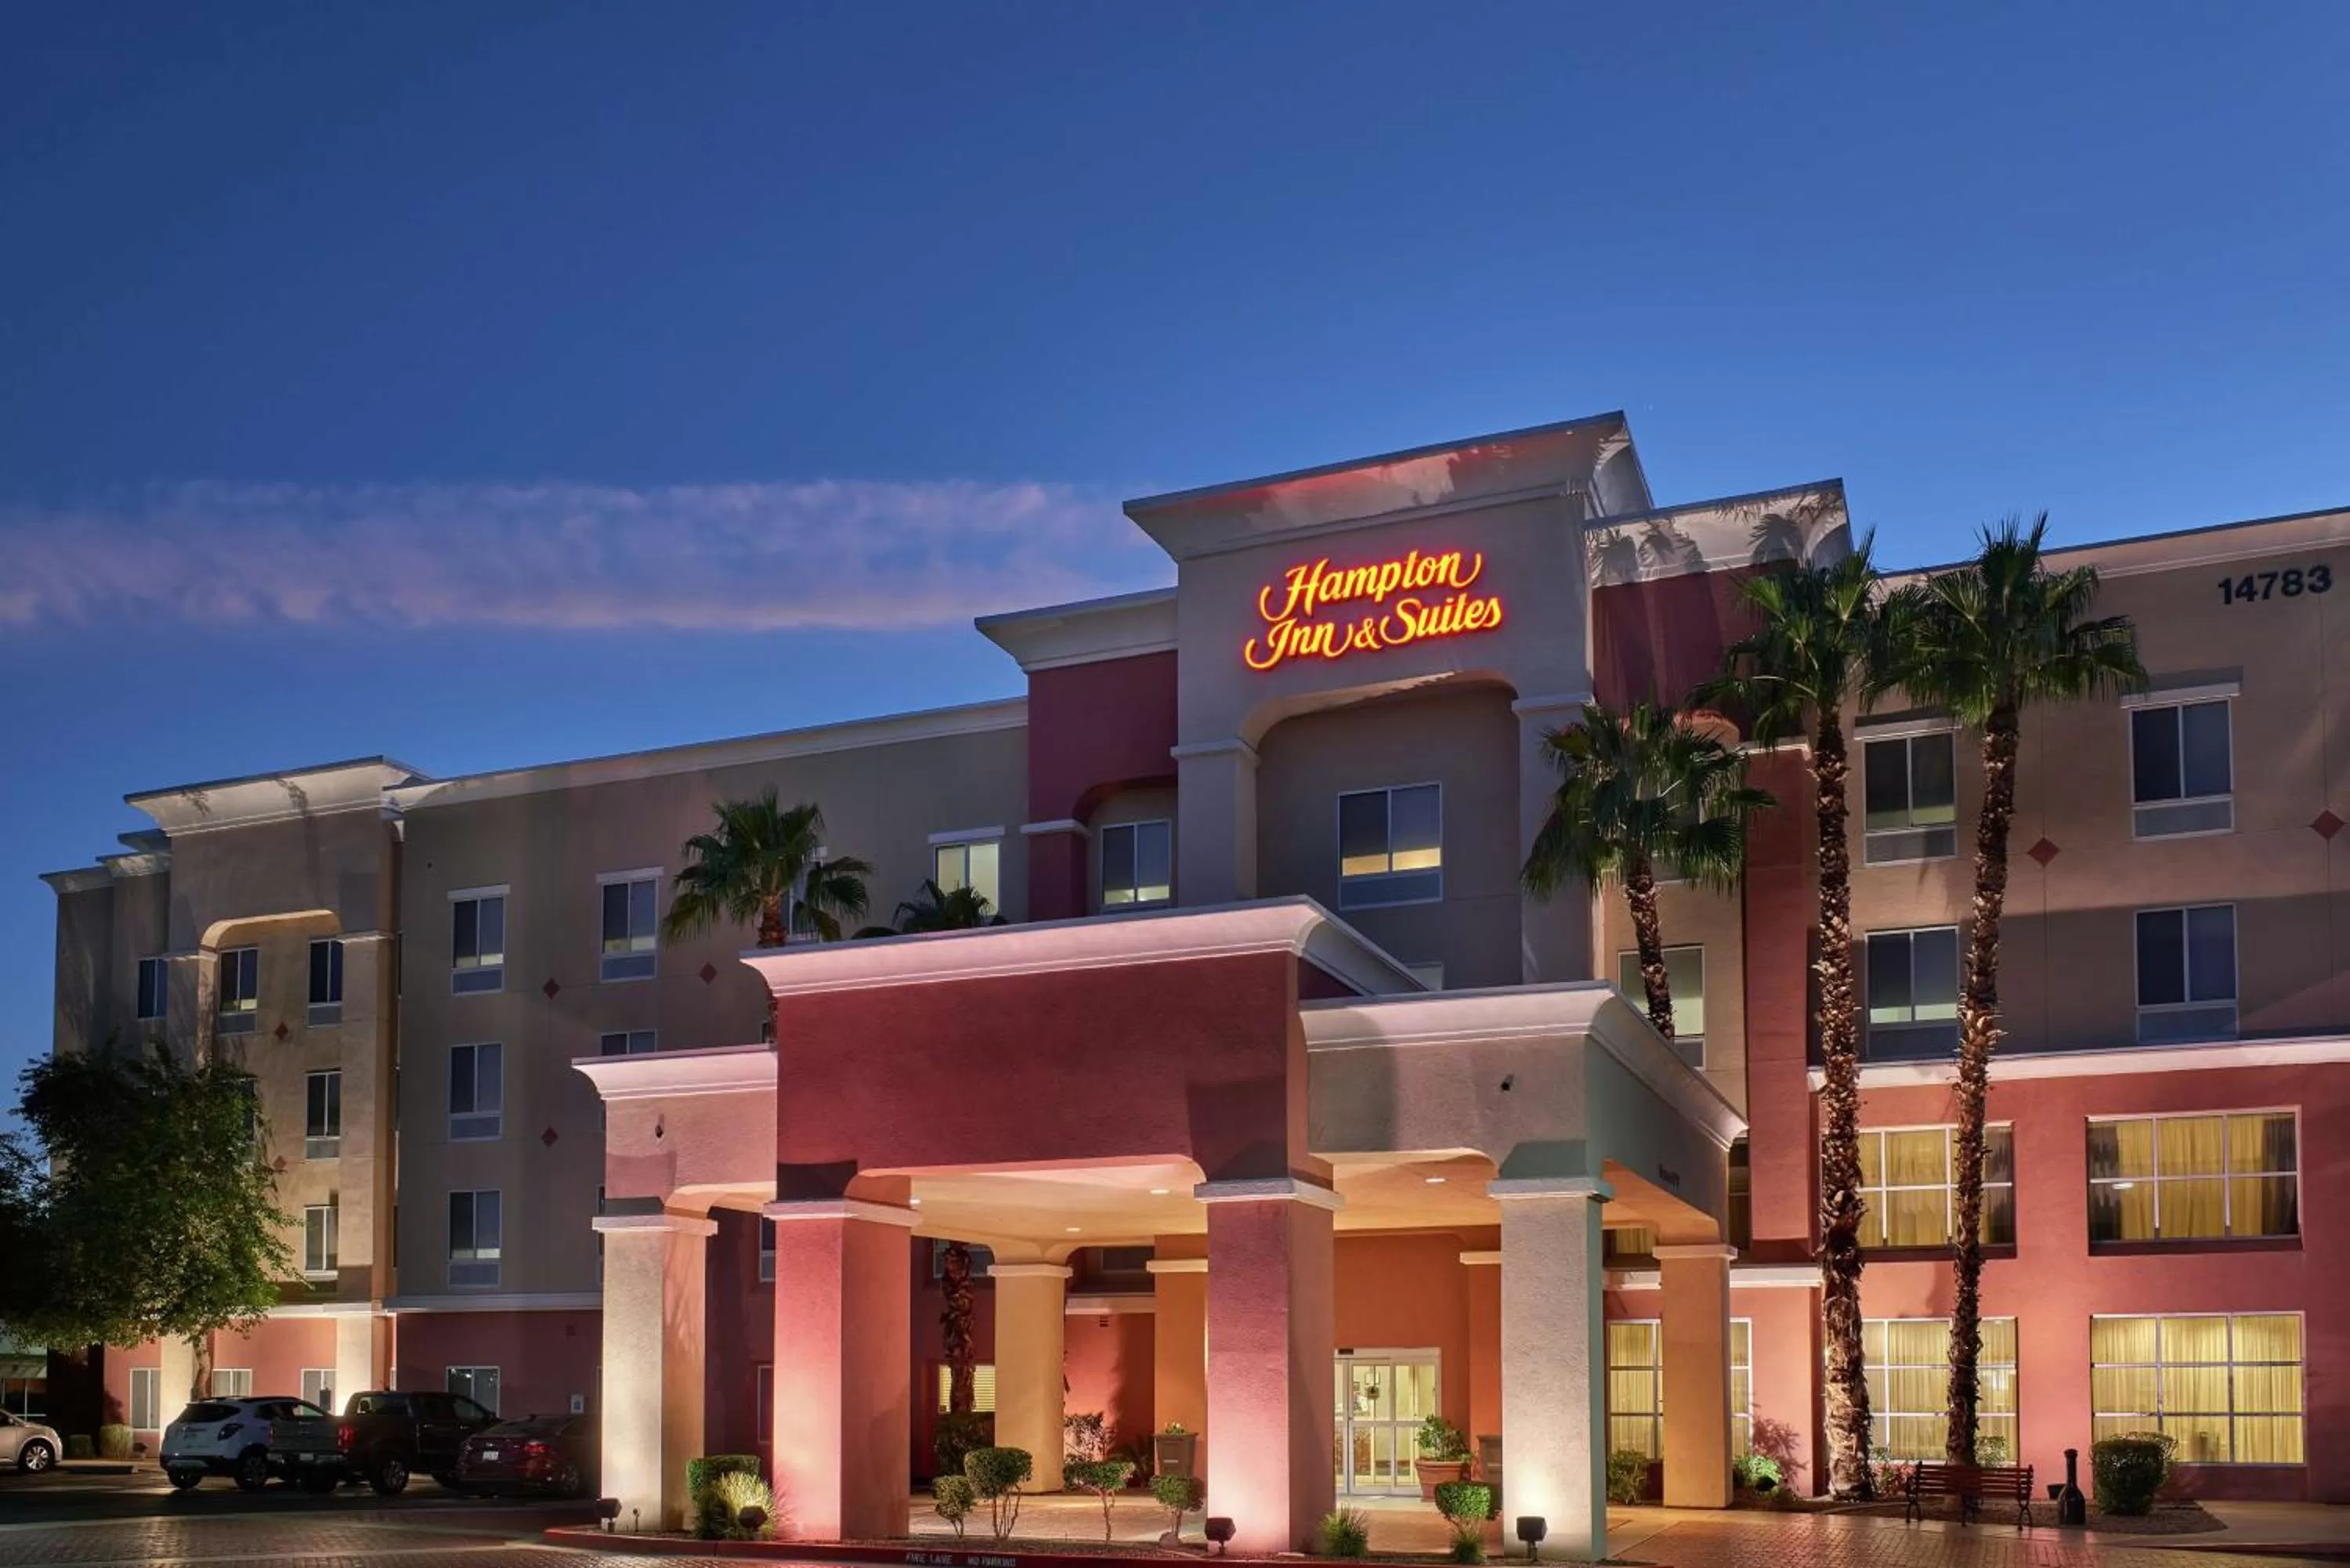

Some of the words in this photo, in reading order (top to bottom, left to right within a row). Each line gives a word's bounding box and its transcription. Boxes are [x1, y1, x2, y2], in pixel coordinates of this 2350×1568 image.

[1259, 550, 1482, 621] Hampton
[2218, 564, 2333, 605] 14783
[1244, 617, 1354, 669] Inn
[1354, 618, 1383, 649] &
[1379, 592, 1502, 644] Suites
